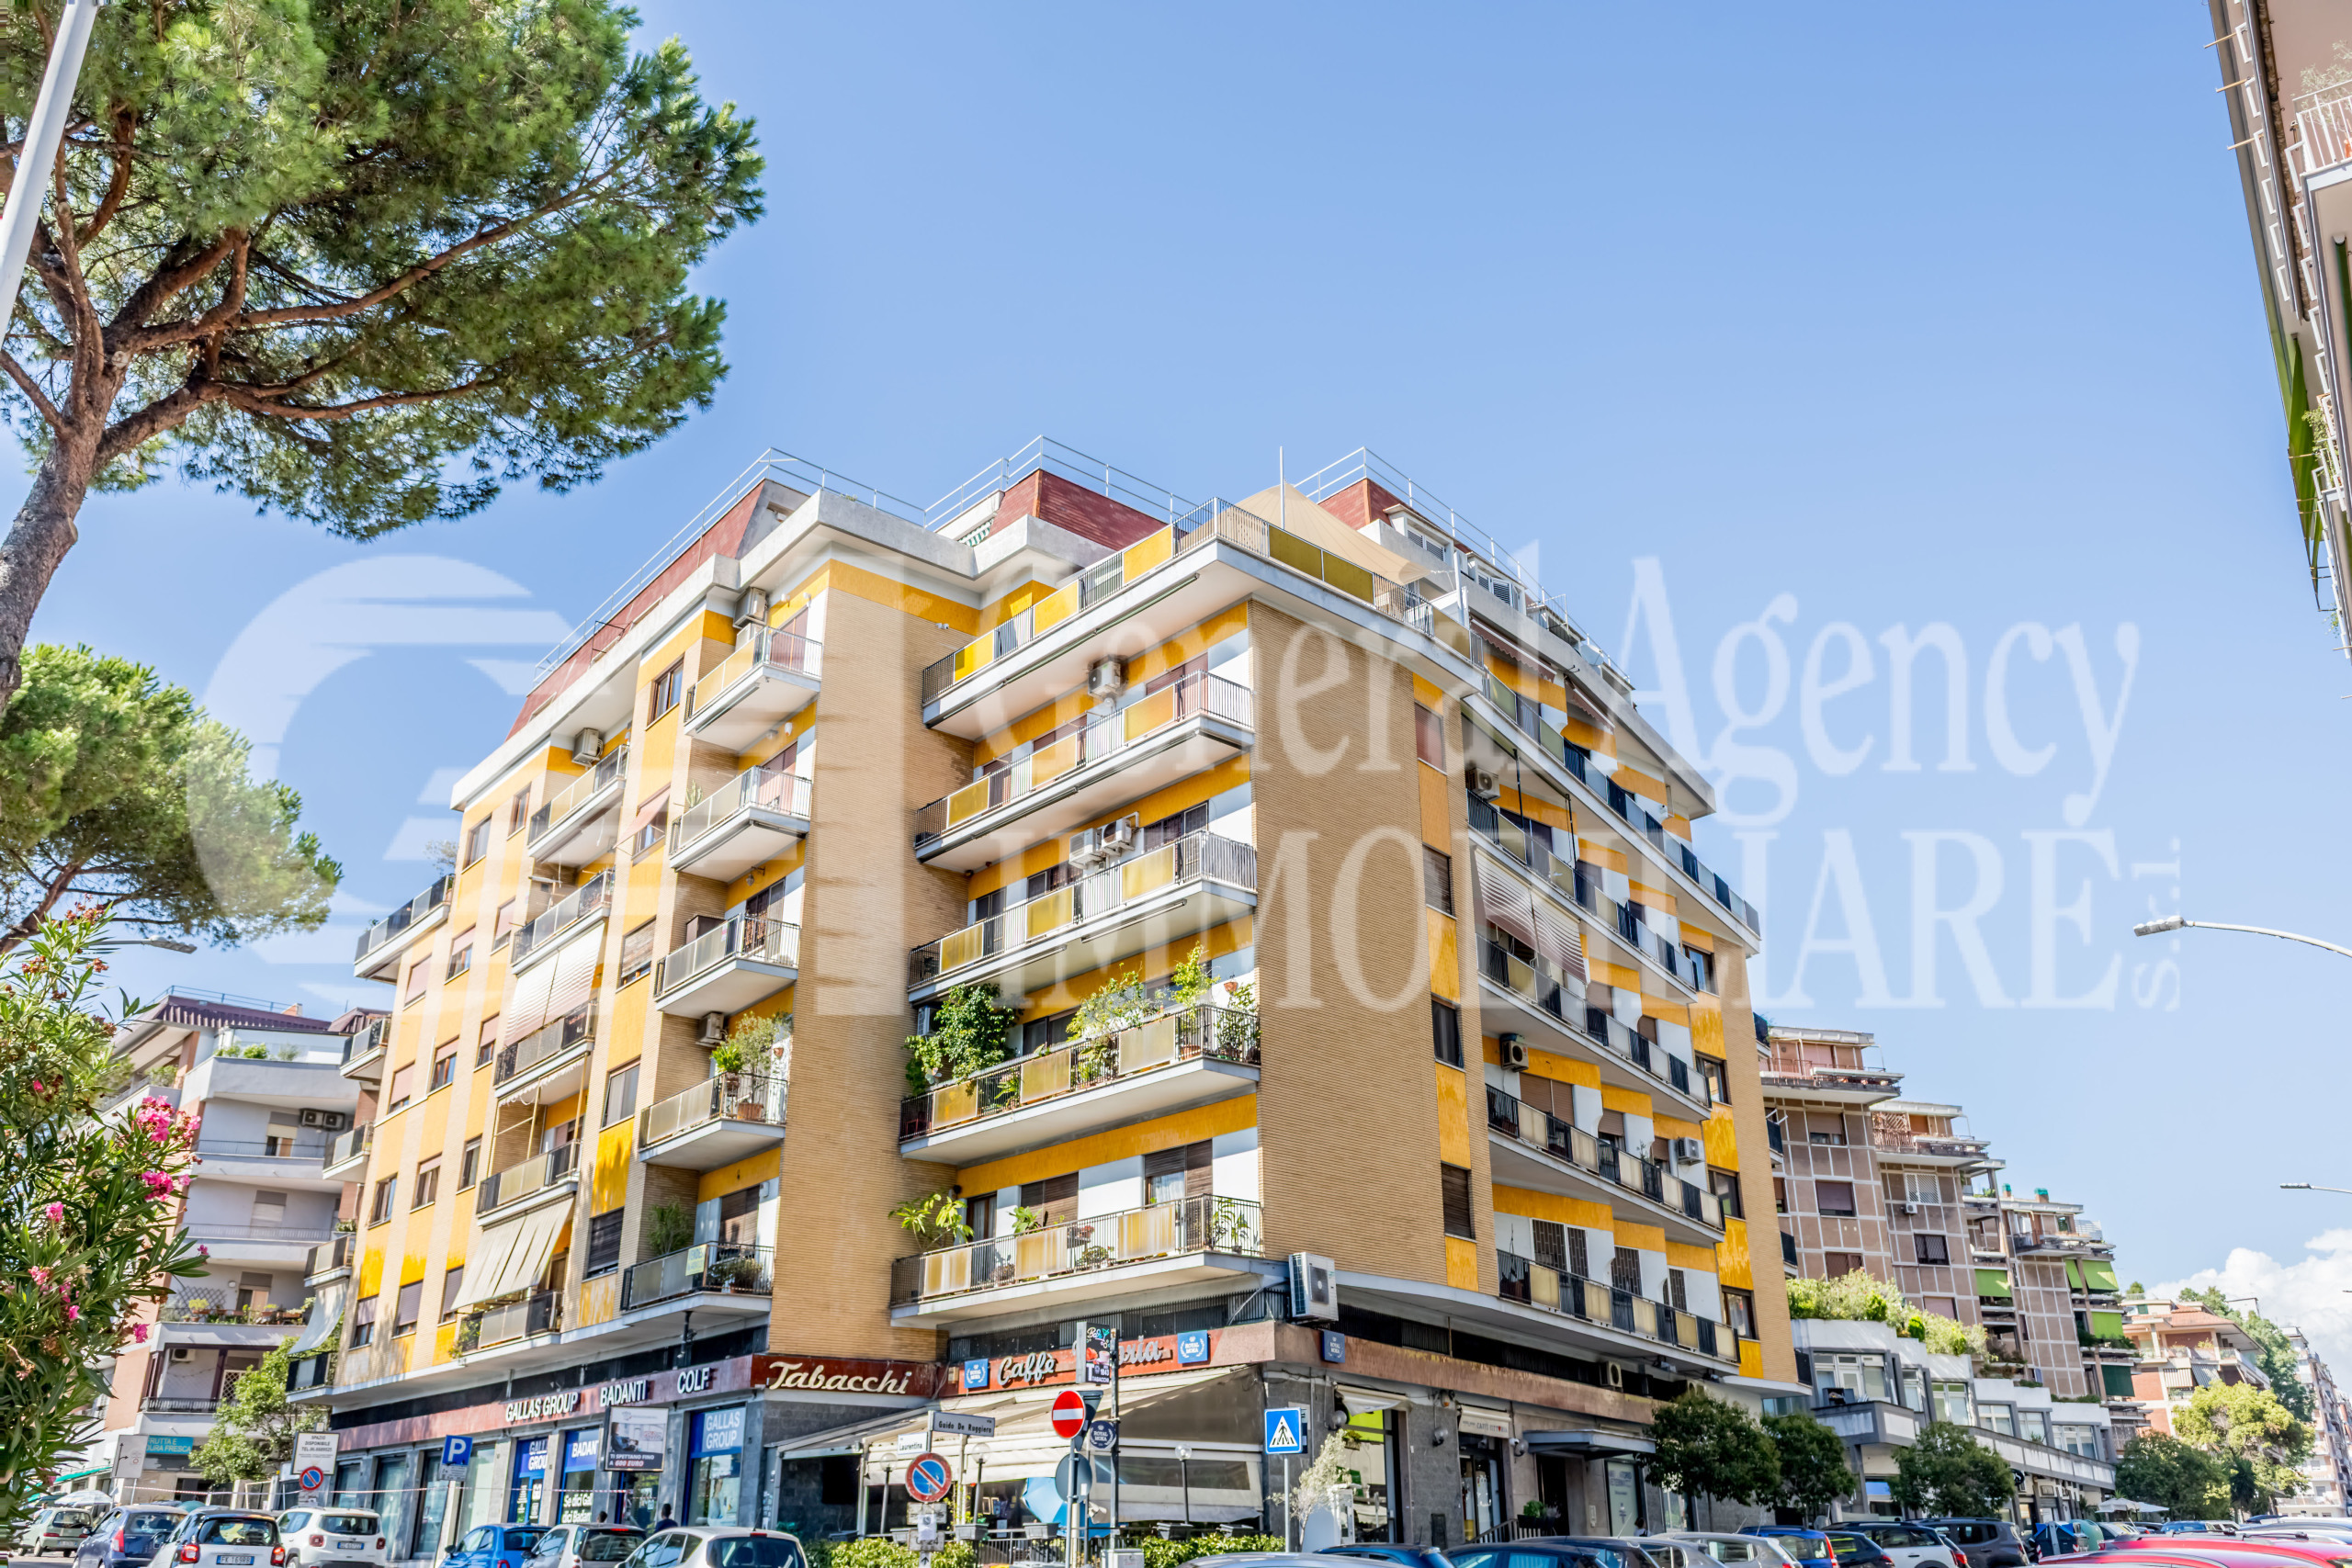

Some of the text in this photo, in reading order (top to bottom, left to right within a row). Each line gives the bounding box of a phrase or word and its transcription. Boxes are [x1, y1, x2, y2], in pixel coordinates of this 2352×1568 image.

[769, 1361, 912, 1394] Tabacchi
[997, 1351, 1055, 1386] Caffè
[505, 1367, 710, 1422] GALLAS GROUP BADANTI COLF
[706, 1411, 741, 1432] GALLAS
[938, 1420, 992, 1434] Guido De Ruggiero
[447, 1438, 467, 1462] P
[706, 1430, 737, 1450] GROUP
[899, 1442, 922, 1451] Laurentina
[528, 1453, 548, 1472] GROU
